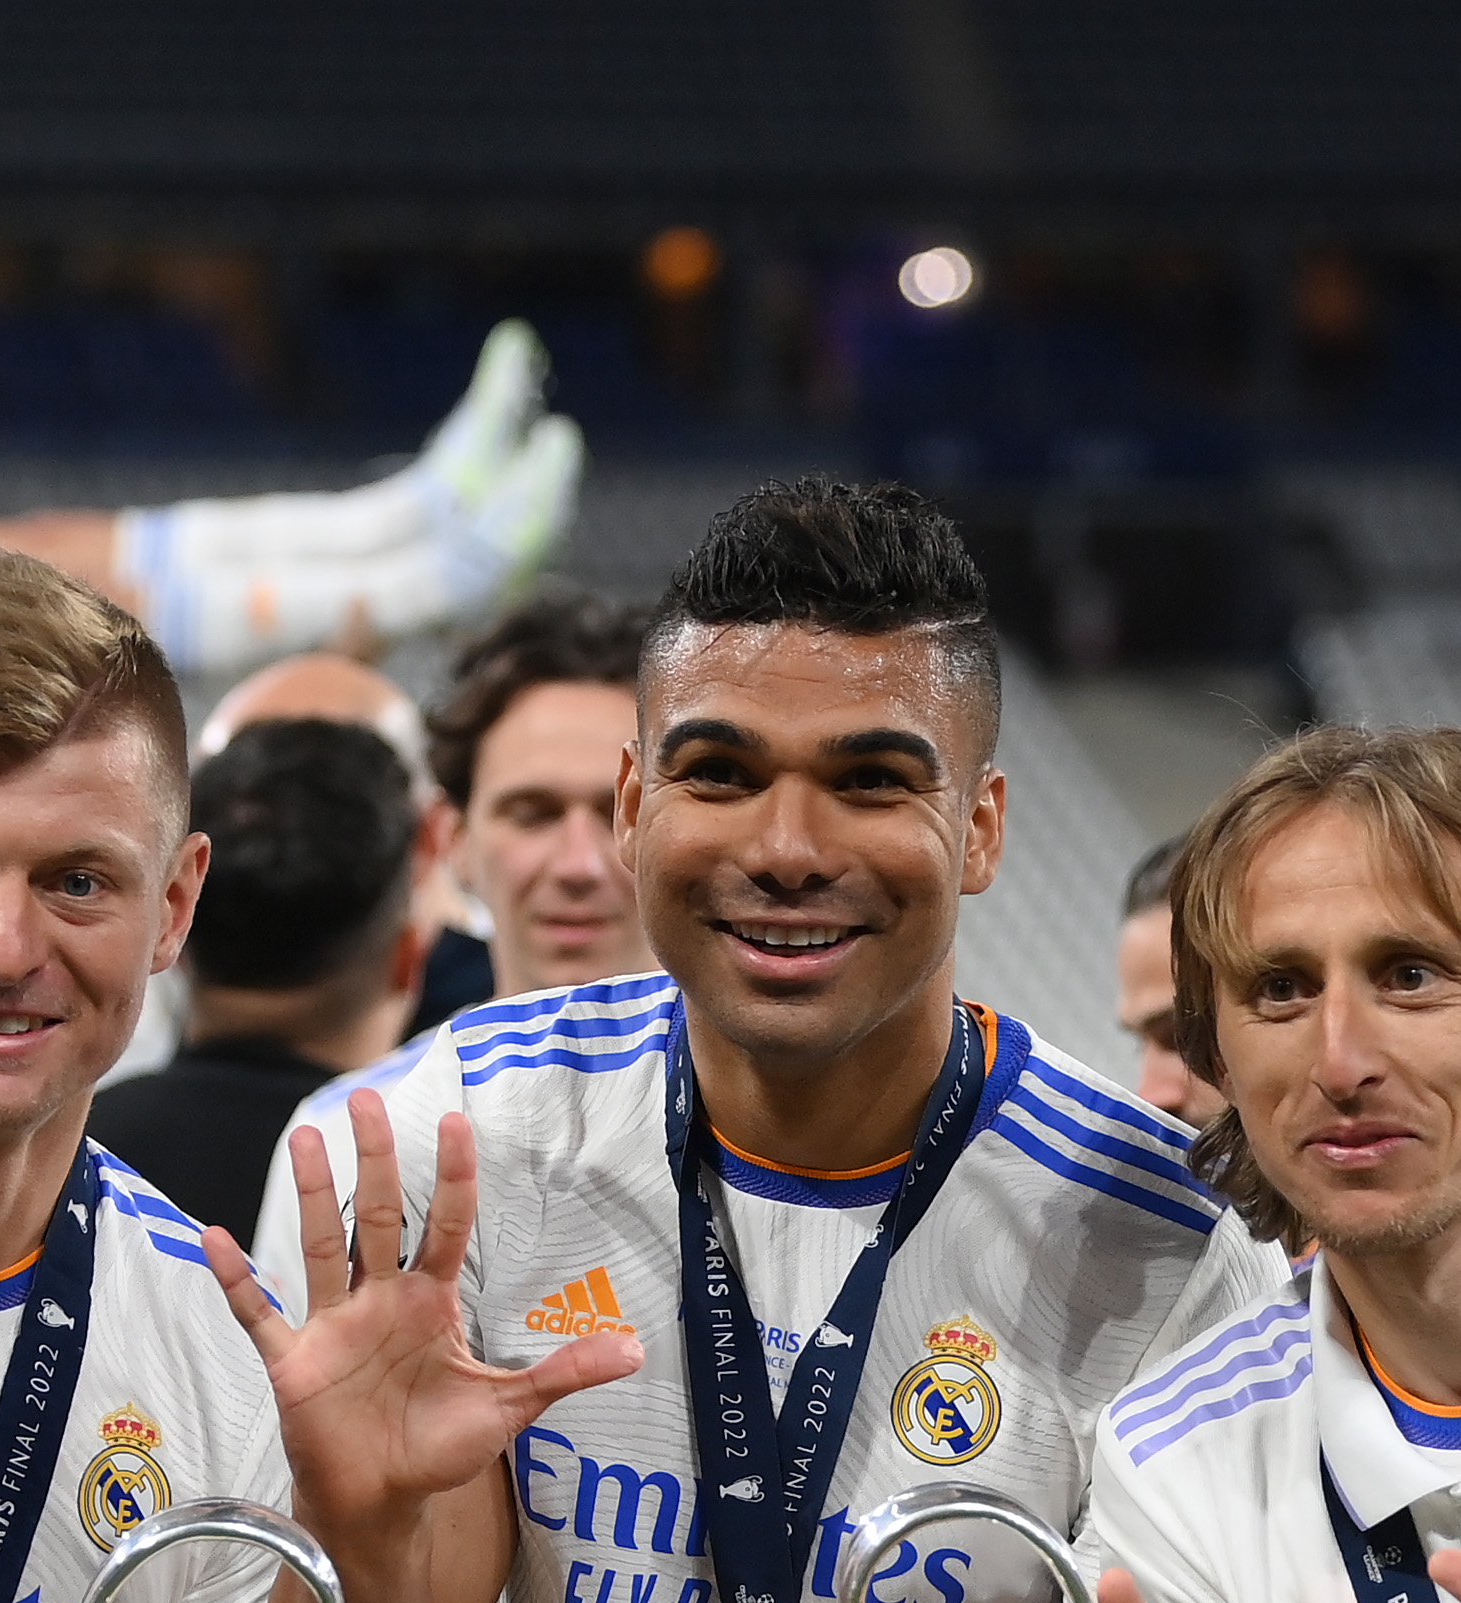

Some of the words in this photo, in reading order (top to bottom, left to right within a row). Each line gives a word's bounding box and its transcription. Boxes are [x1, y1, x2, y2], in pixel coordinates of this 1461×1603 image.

[710, 1308, 739, 1383] FINAL
[2, 1422, 40, 1491] FINAL
[26, 1344, 59, 1411] 2022
[719, 1393, 749, 1459] 2022
[803, 1367, 836, 1433] 2022
